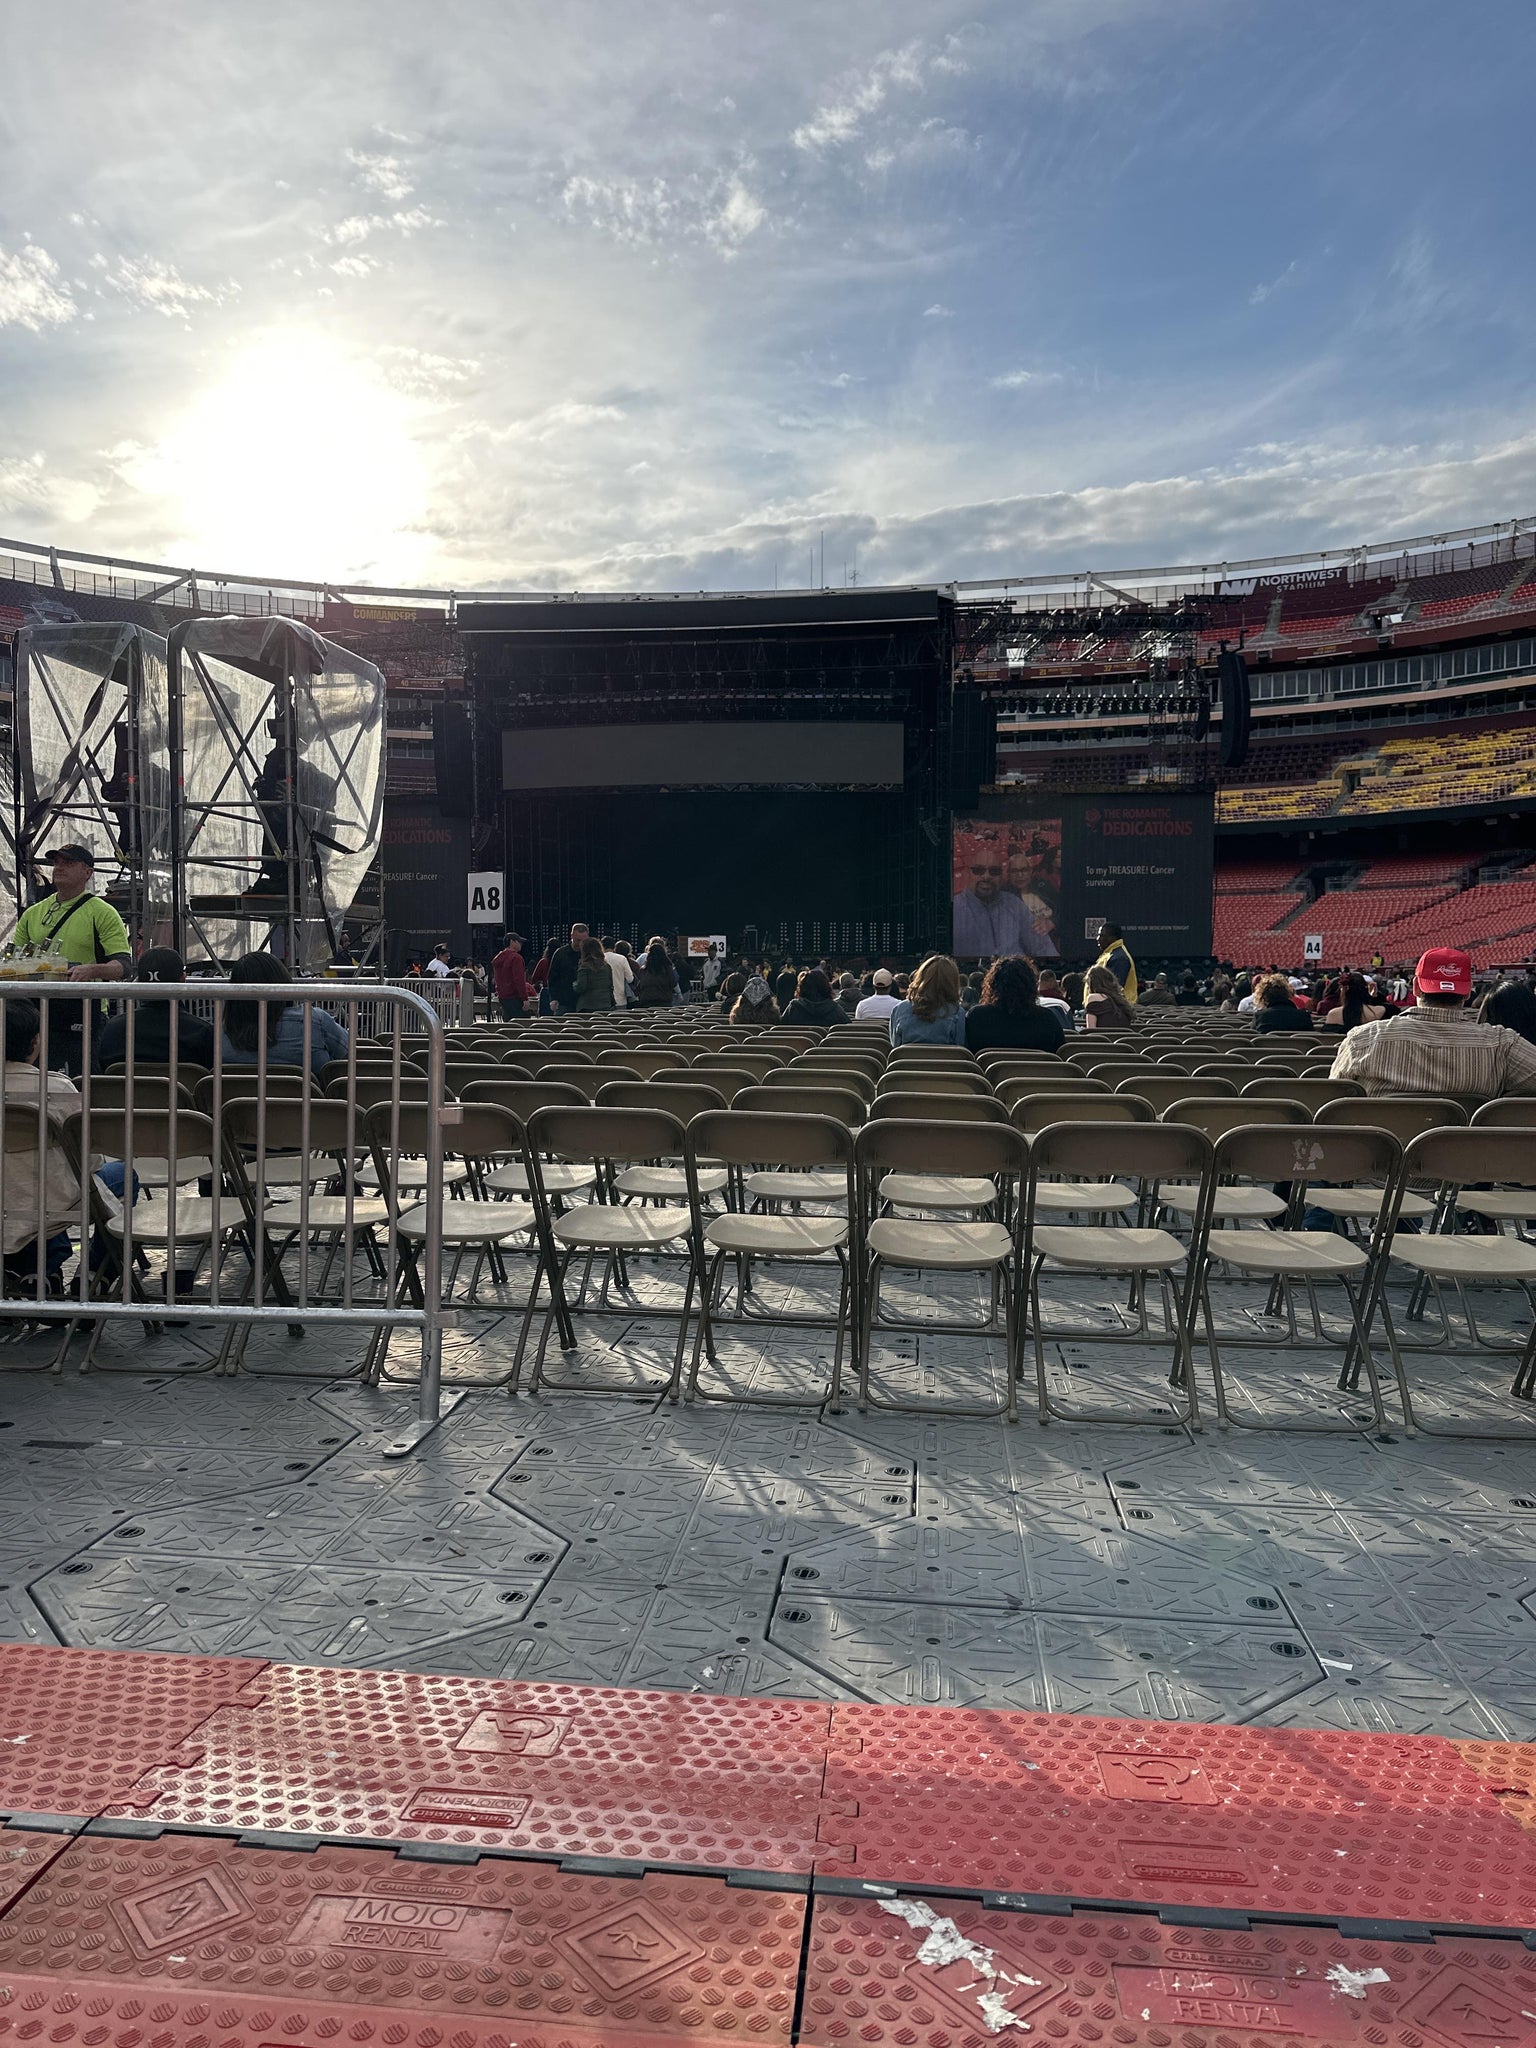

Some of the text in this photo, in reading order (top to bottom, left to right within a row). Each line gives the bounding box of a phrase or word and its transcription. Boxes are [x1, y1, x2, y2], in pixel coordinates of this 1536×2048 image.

[1260, 569, 1342, 587] NORTHWEST
[1276, 581, 1326, 593] STADIUM
[353, 608, 417, 620] COMMANDERS
[1103, 808, 1171, 818] THE ROMANTIC
[1103, 821, 1193, 836] DEDICATIONS
[383, 829, 452, 844] EDICATIONS
[383, 873, 415, 881] REASURE!
[415, 873, 438, 881] Cancer
[1086, 866, 1175, 876] To my TREASURE! Cancer
[1086, 879, 1116, 887] survivor
[471, 887, 500, 911] A8
[1306, 942, 1321, 954] A4
[376, 1879, 464, 1896] CABLEGUARD
[354, 1901, 458, 1927] MOJO
[341, 1926, 444, 1950] RENTAL
[1177, 2000, 1294, 2028] RENTAL
